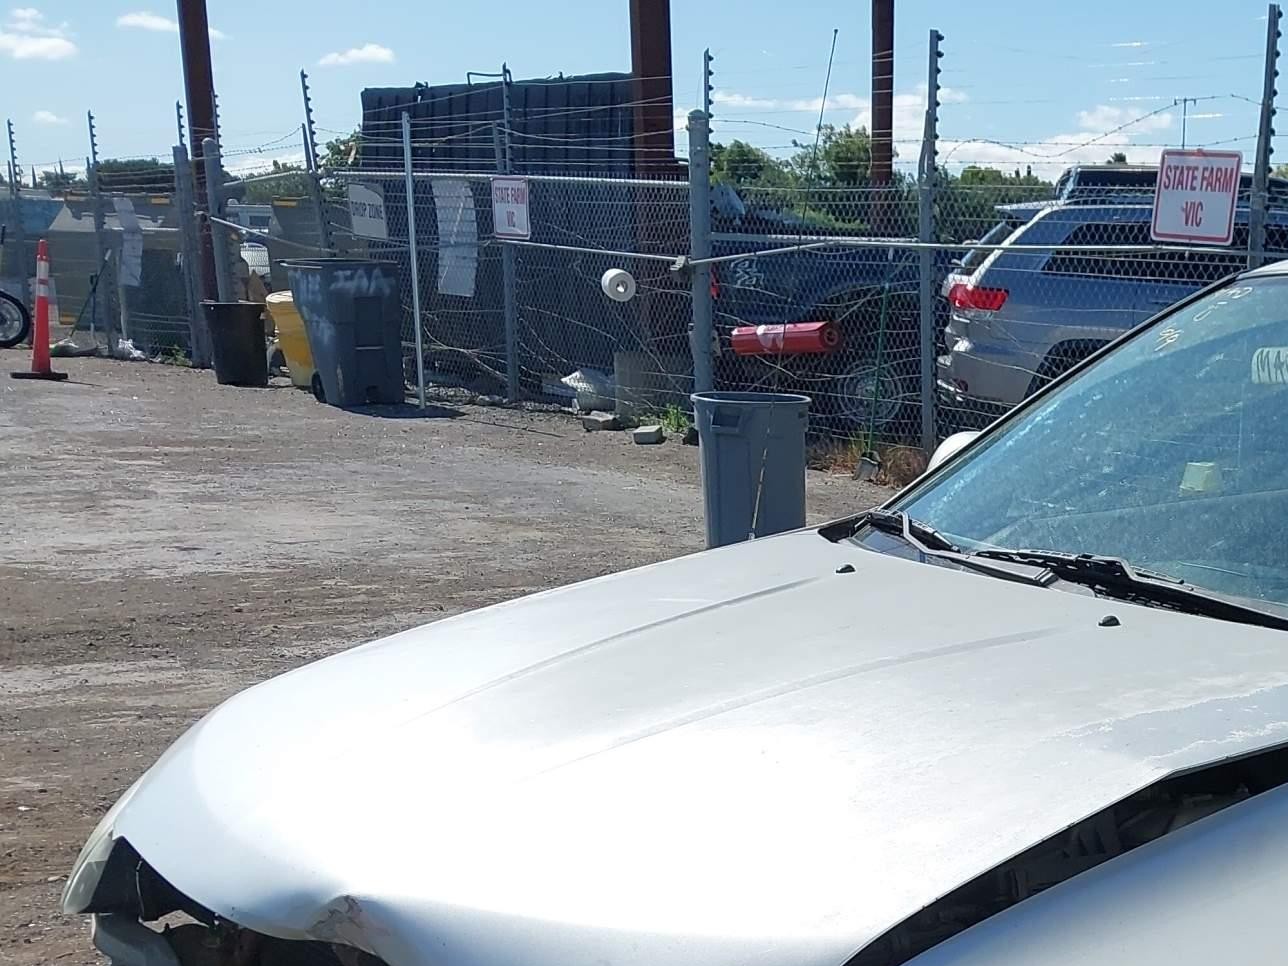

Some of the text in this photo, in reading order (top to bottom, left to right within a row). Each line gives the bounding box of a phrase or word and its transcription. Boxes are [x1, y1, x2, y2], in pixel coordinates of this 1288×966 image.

[1163, 165, 1235, 193] STATE FARM
[495, 186, 510, 204] STATE
[1184, 201, 1204, 228] VIC
